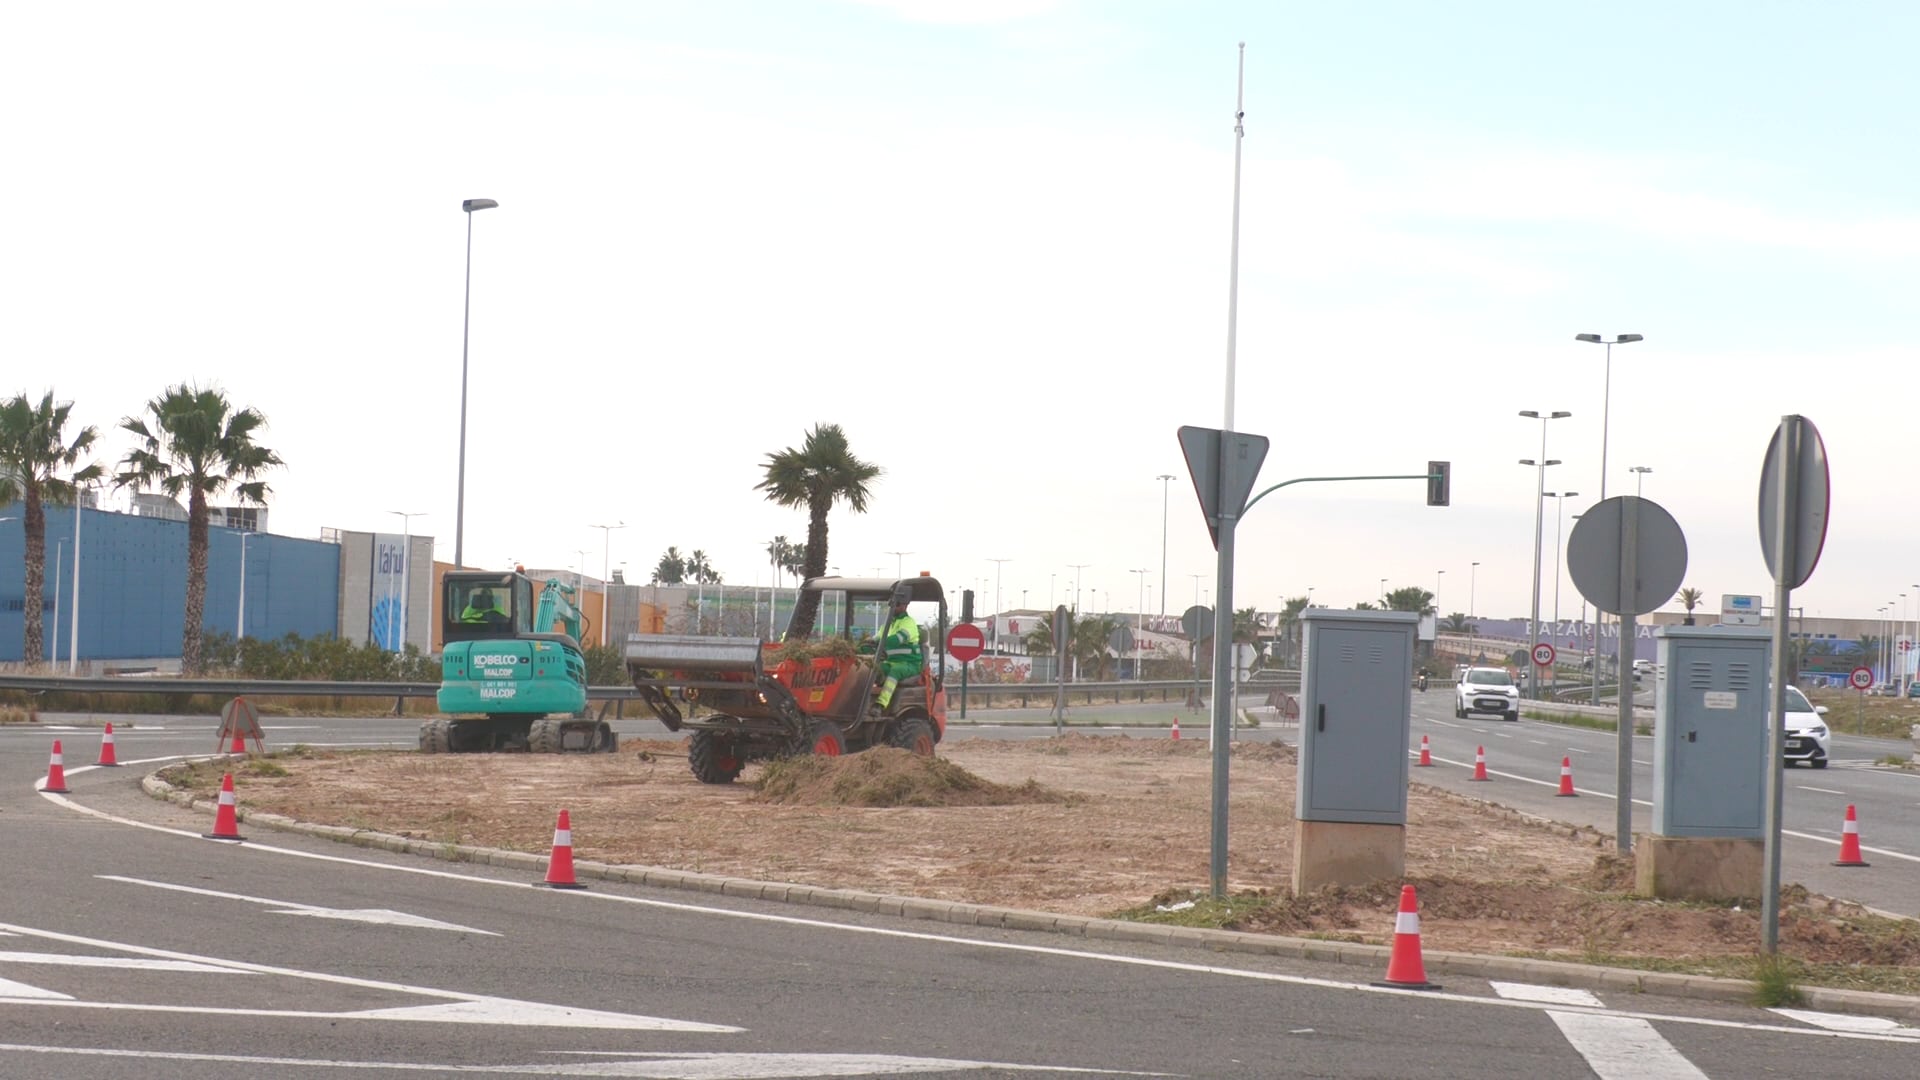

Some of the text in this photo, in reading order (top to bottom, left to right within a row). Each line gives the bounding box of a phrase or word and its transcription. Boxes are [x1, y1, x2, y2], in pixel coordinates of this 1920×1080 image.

[1536, 651, 1550, 659] 80
[473, 655, 518, 665] KOBELCO
[484, 668, 513, 677] MALCOP
[1855, 674, 1869, 682] 80
[480, 688, 517, 698] MALCOP
